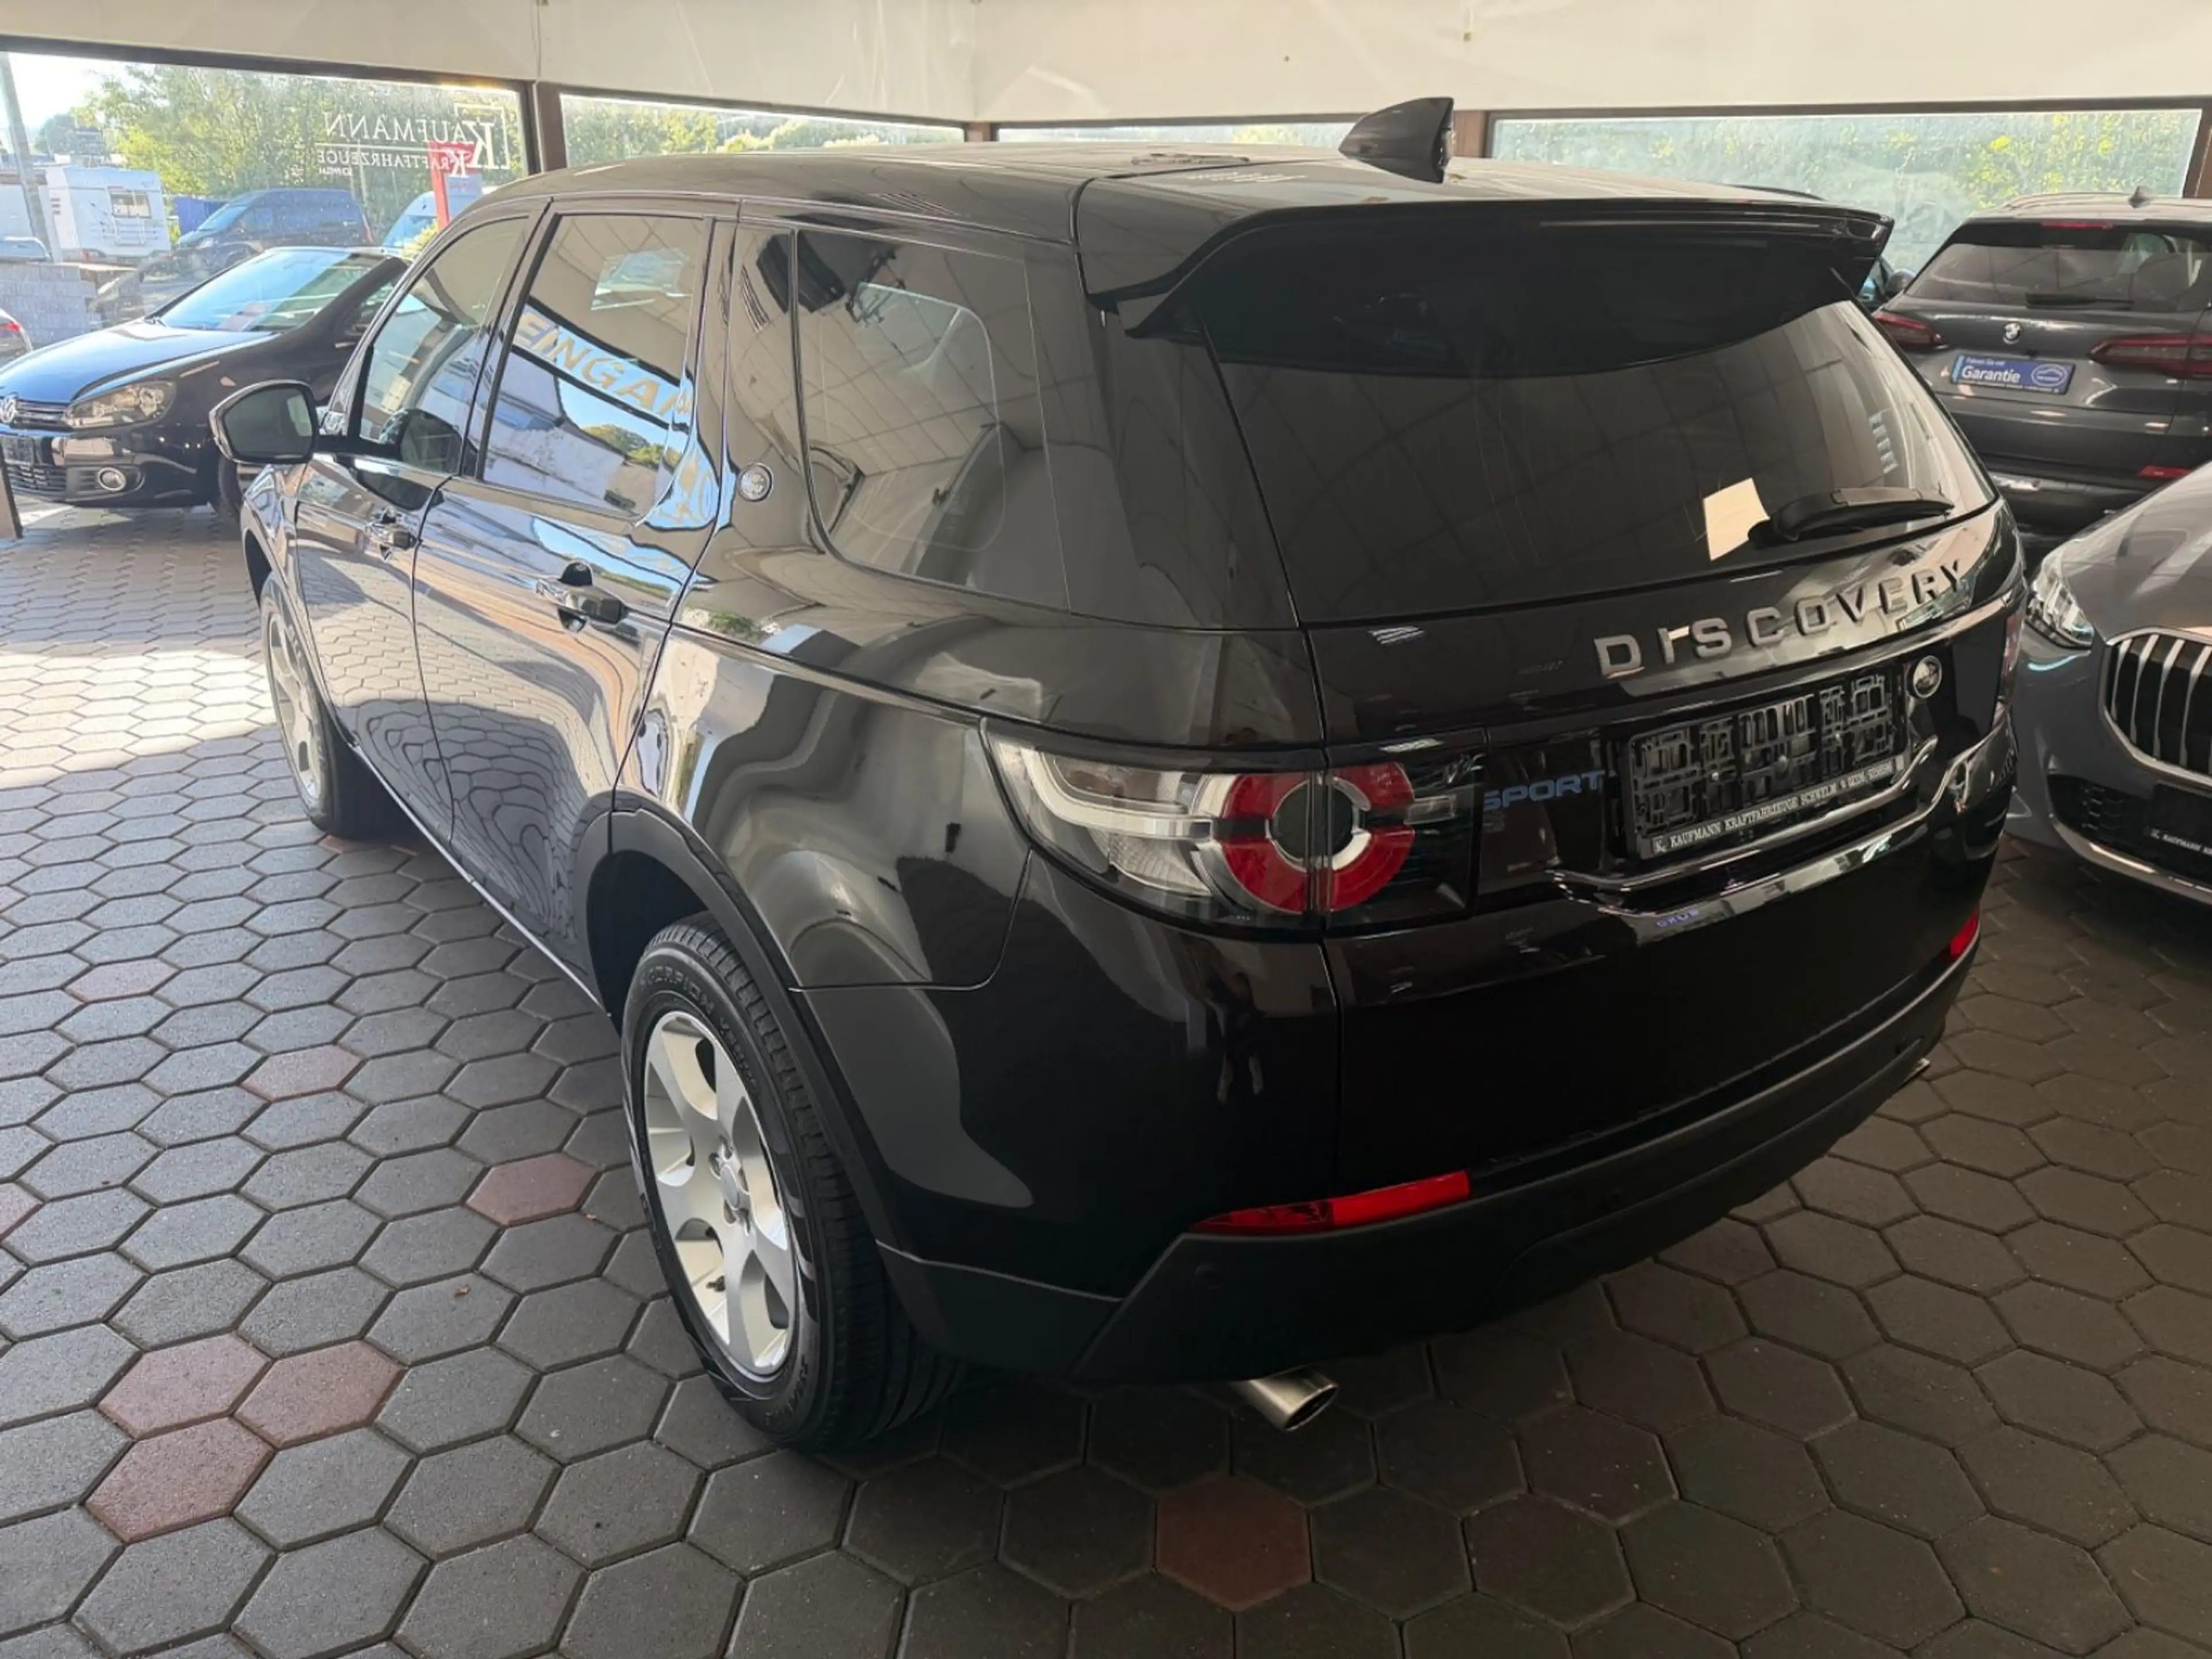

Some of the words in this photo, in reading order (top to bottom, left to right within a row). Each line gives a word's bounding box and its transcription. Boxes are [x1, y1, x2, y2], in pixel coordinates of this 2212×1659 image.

[1962, 365, 2021, 383] Garantie
[1594, 559, 1961, 678] DISCOVERY
[1483, 770, 1605, 811] SPORT
[1670, 823, 1721, 847] KAUFMANN
